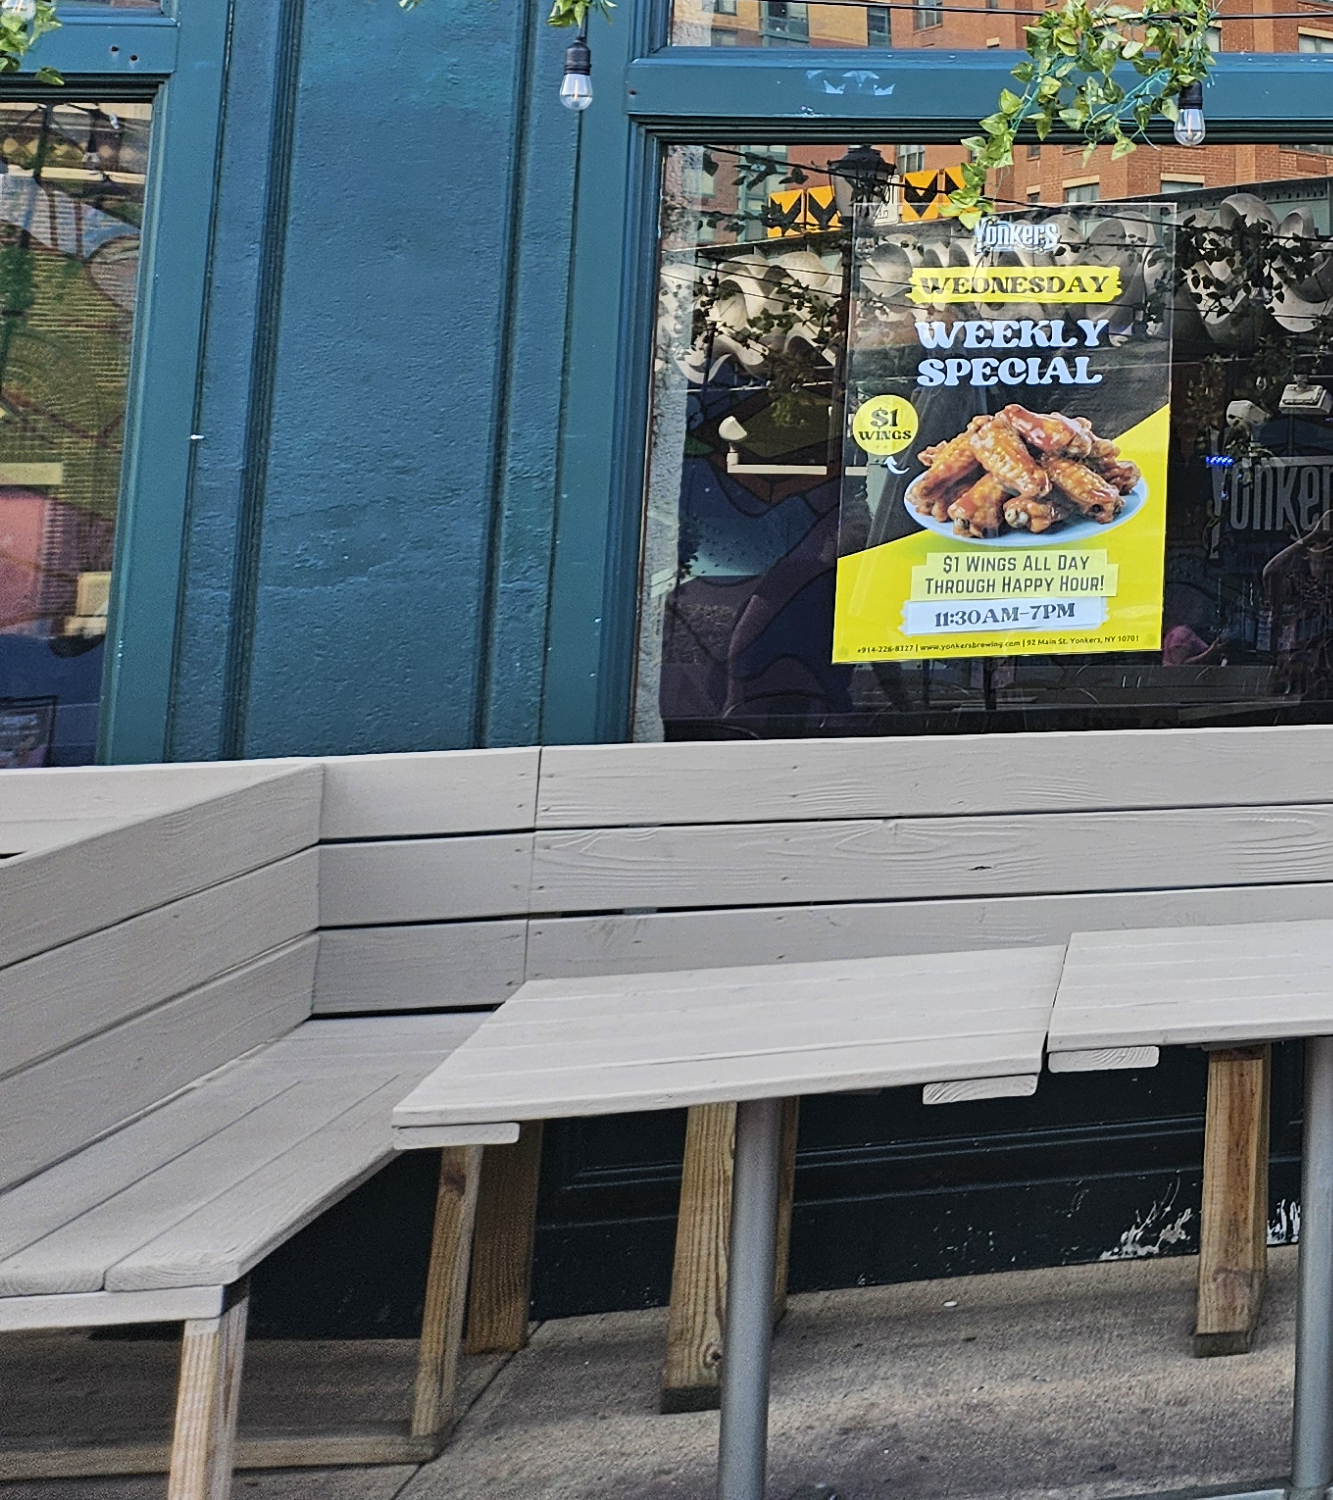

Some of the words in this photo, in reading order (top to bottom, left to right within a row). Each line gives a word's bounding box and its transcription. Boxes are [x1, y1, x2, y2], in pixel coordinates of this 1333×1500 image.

[974, 217, 1061, 254] Yonkers
[919, 275, 1110, 295] WEDNESDAY
[914, 319, 1110, 349] WEEKLY
[917, 356, 1103, 387] SPECIAL
[871, 408, 898, 429] $1
[858, 429, 912, 441] WINGS
[943, 554, 960, 574] $1
[1023, 554, 1051, 571] ALL
[1038, 638, 1056, 646] Main
[1104, 635, 1116, 643] NY
